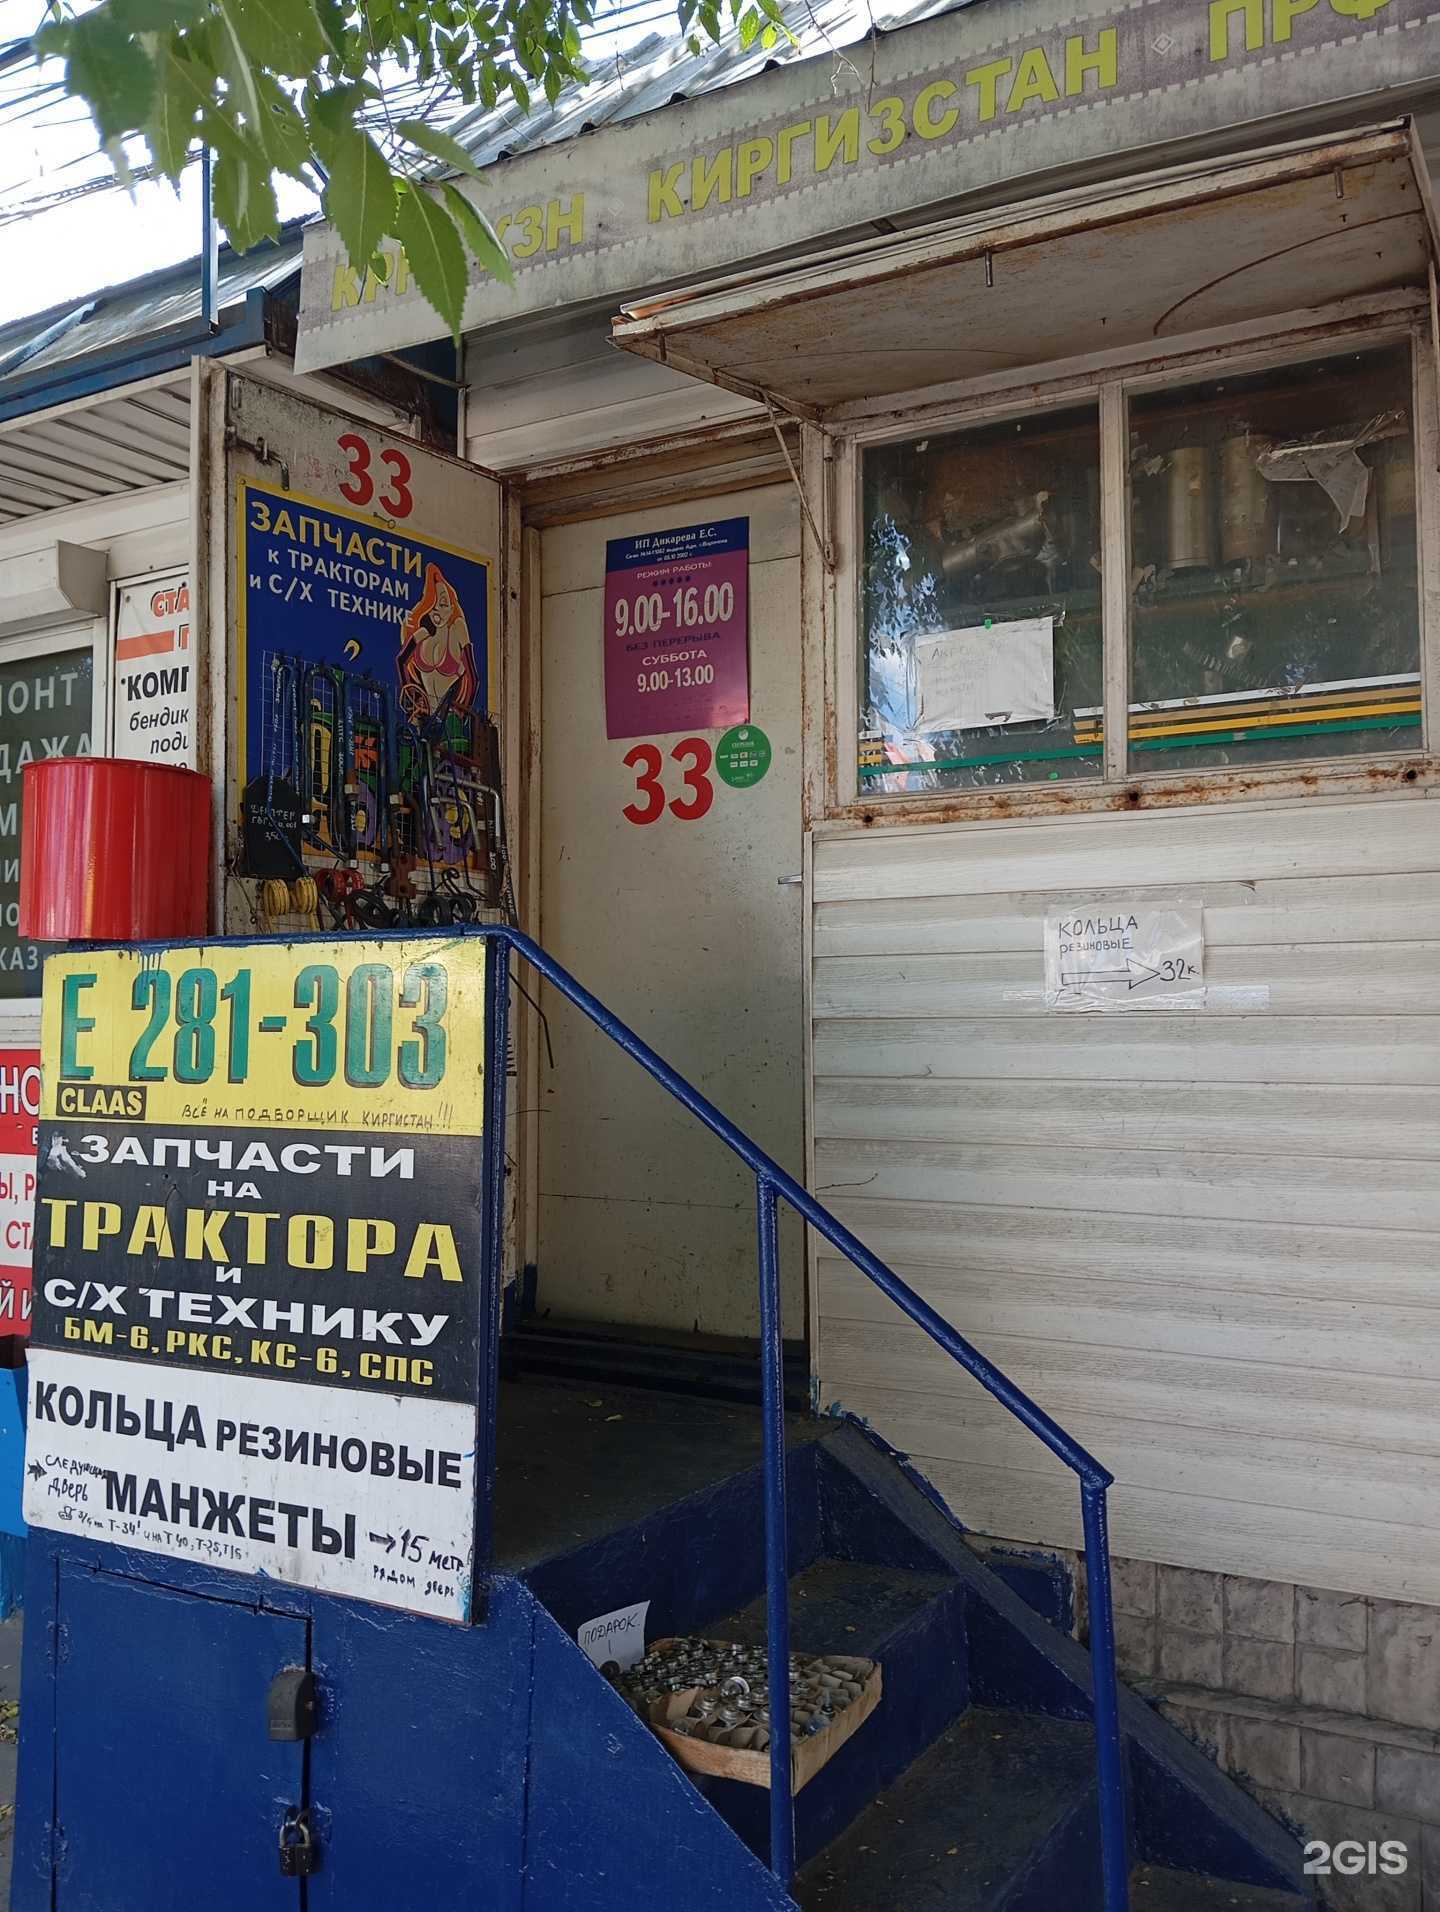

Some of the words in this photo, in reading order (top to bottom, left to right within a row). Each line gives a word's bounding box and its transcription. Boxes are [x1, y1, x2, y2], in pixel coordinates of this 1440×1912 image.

[648, 27, 1118, 223] КИРГИЗСТАН
[337, 433, 413, 518] 33
[250, 502, 422, 577] ЗАПЧАСТИ
[634, 536, 651, 550] ИП
[288, 549, 409, 600] ТРАКТОРАМ
[637, 568, 670, 579] РЕЖИМ
[672, 561, 712, 574] РАБОТЫ
[269, 574, 313, 602] С/Х
[327, 589, 414, 627] ТЕХНИКЕ
[615, 582, 734, 637] 9.00-16.00
[626, 641, 651, 652] БЕЗ
[652, 631, 721, 649] ПЕРЕРЫВА
[642, 649, 708, 666] СУББОТА
[637, 664, 714, 693] 9.00-13.00
[622, 737, 714, 826] 33
[1059, 915, 1138, 939] КОЛЬЦА
[129, 963, 448, 1089] 281-303
[60, 1088, 143, 1116] CLAAS
[214, 1109, 229, 1120] НА
[235, 1108, 350, 1125] ПОДБОРЩИК
[79, 1135, 415, 1179] ЗАПЧАСТИ
[207, 1180, 262, 1199] НА
[42, 1198, 463, 1282] ТРАКТОРА
[216, 1266, 242, 1284] И
[44, 1279, 127, 1315] С/Х
[139, 1288, 449, 1346] ТЕХНИКУ
[359, 1352, 434, 1386] СПС
[35, 1381, 207, 1453] КОЛЬЦА
[216, 1419, 461, 1489] РЕЗИНОВЫЕ
[105, 1470, 356, 1559] МАНЖЕТЫ
